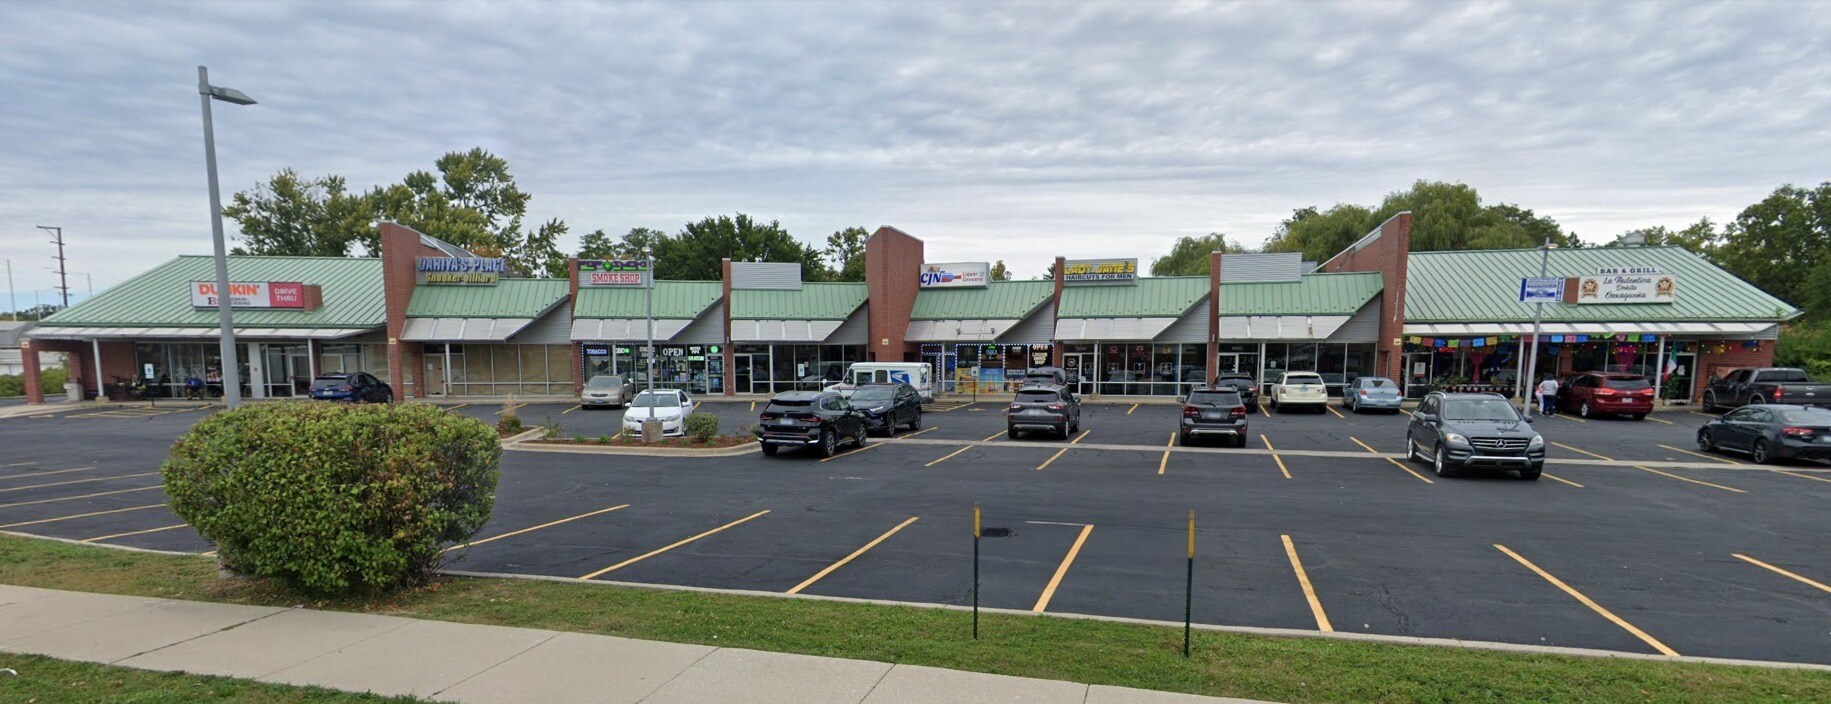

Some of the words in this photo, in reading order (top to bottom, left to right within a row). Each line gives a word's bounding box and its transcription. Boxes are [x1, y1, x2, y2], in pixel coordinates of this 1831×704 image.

[419, 258, 468, 272] DARIYA'S
[472, 258, 506, 272] PLACE
[425, 272, 461, 283] Snooker
[592, 273, 619, 283] SMOKE
[619, 273, 640, 283] SHOP
[920, 271, 942, 285] CJN
[662, 348, 683, 357] OPEN
